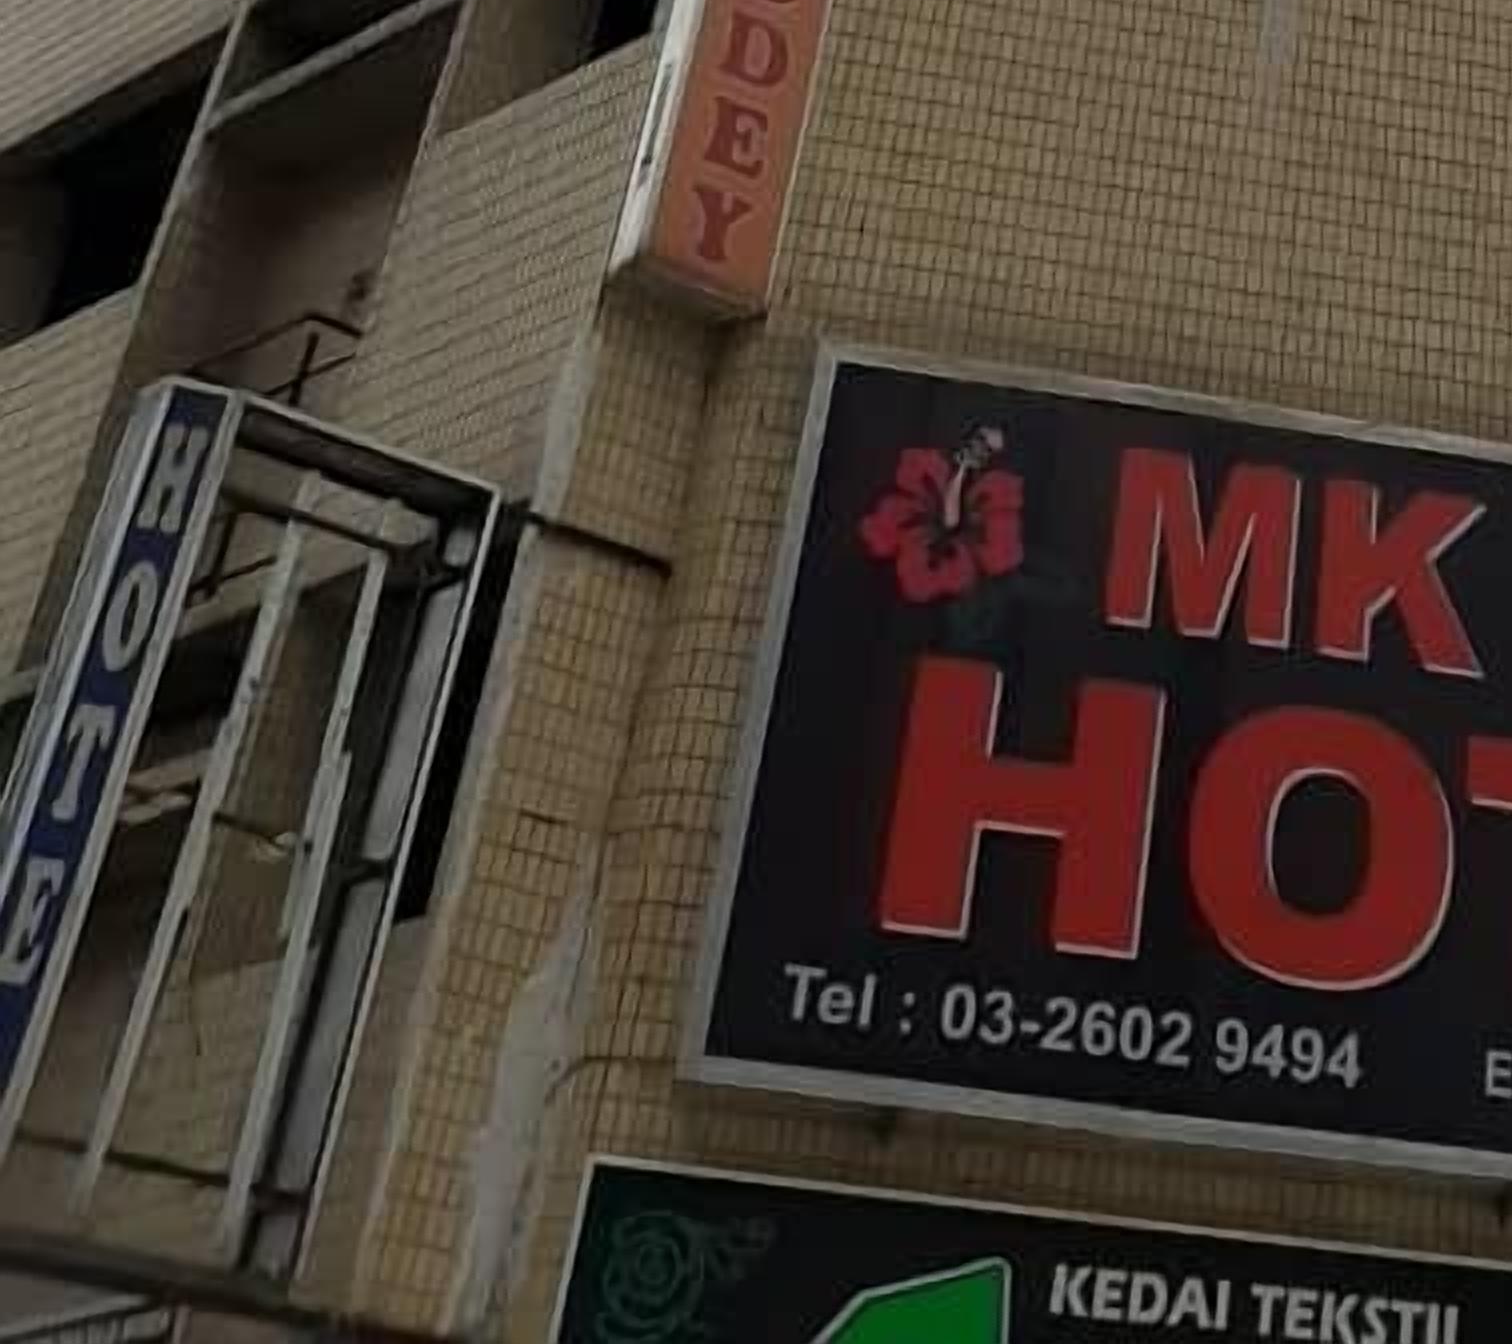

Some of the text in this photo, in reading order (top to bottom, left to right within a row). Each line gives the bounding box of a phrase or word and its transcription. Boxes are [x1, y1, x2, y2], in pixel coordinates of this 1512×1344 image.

[1103, 446, 1488, 680] MK
[784, 963, 876, 1030] Tel
[940, 983, 1193, 1068] 03-2602
[1214, 1018, 1362, 1089] 9494
[1049, 1263, 1231, 1331] KEDAI
